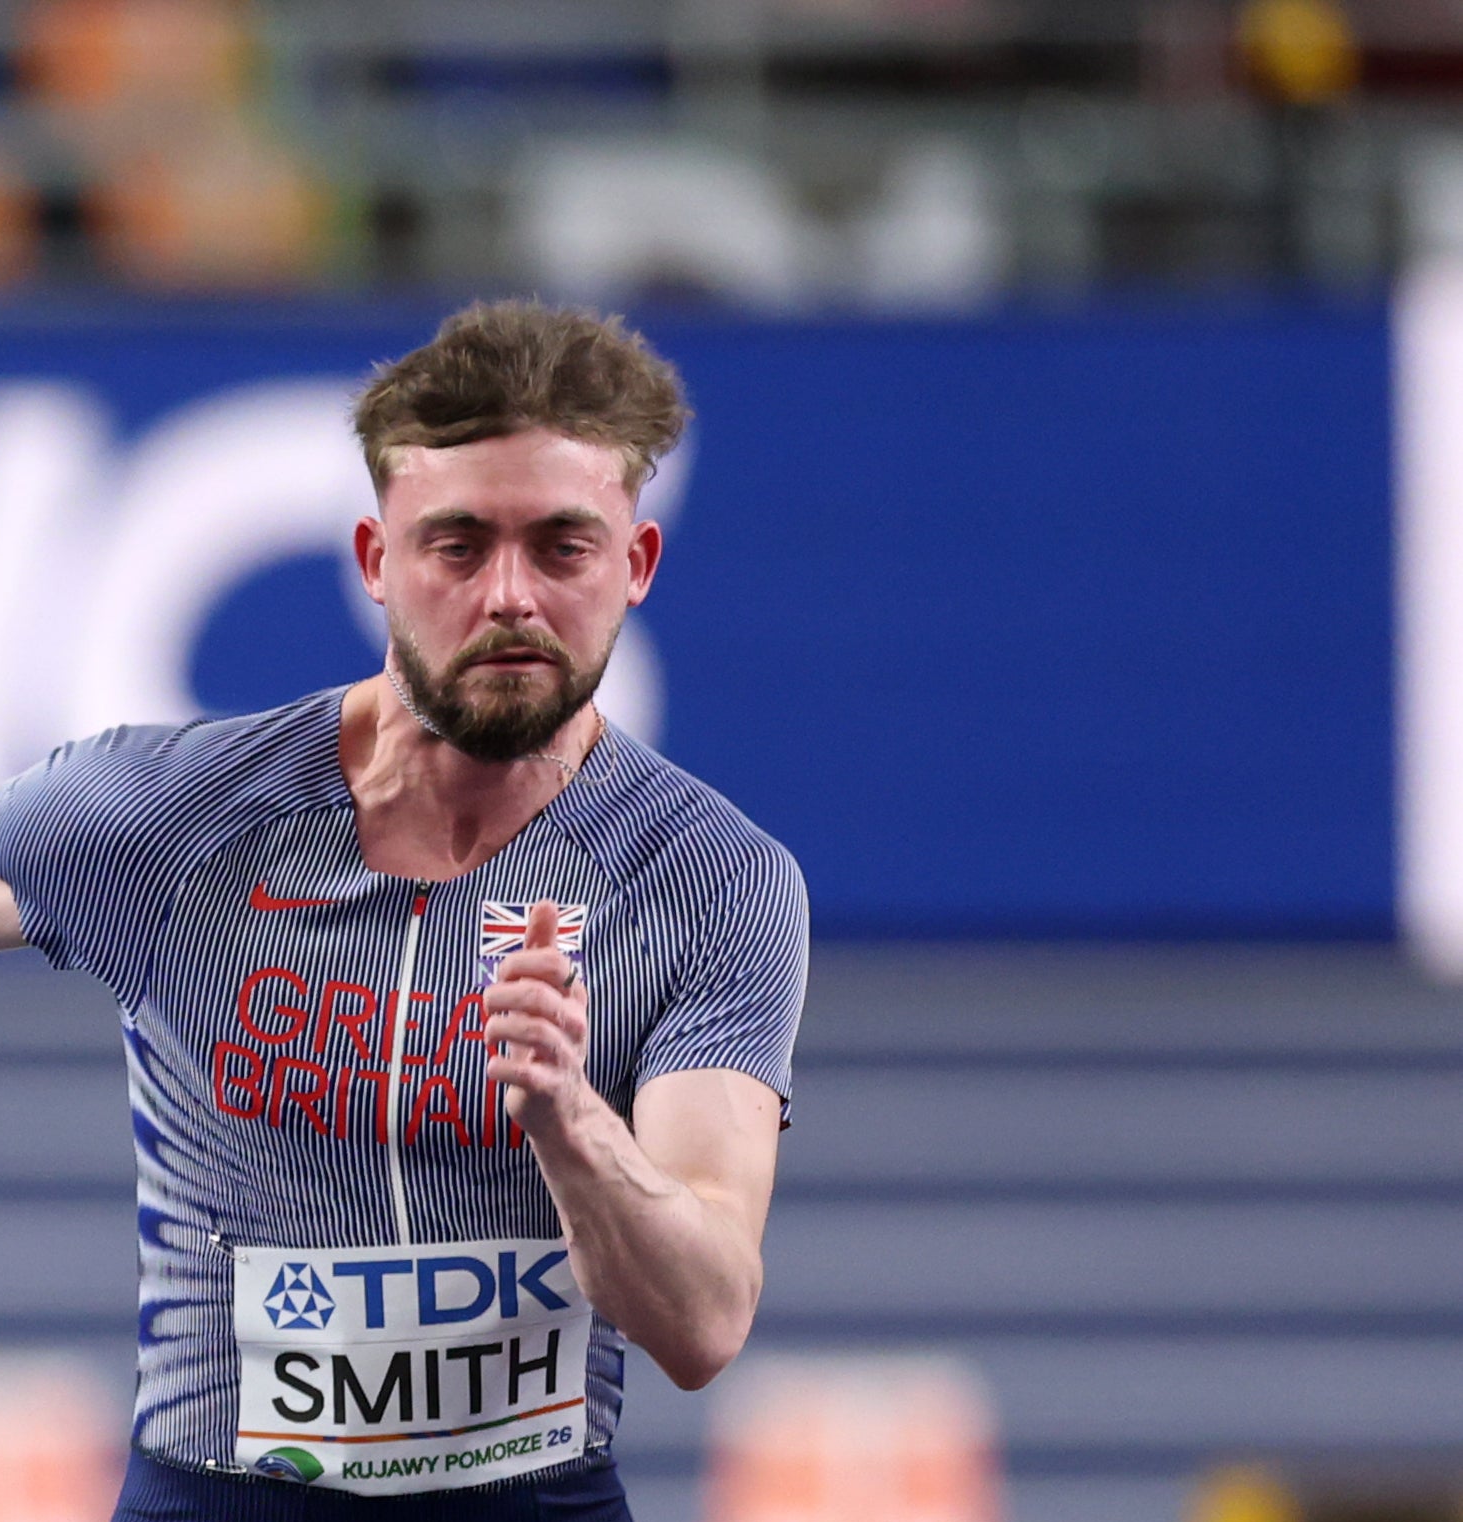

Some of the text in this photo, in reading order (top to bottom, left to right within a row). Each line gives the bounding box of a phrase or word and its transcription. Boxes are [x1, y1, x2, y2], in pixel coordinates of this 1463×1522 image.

[237, 966, 501, 1066] GREA
[213, 1040, 525, 1148] BRITAI
[332, 1250, 571, 1329] TDK
[272, 1329, 561, 1425] SMITH
[342, 1426, 573, 1480] KUJAWY POMORZE 26
